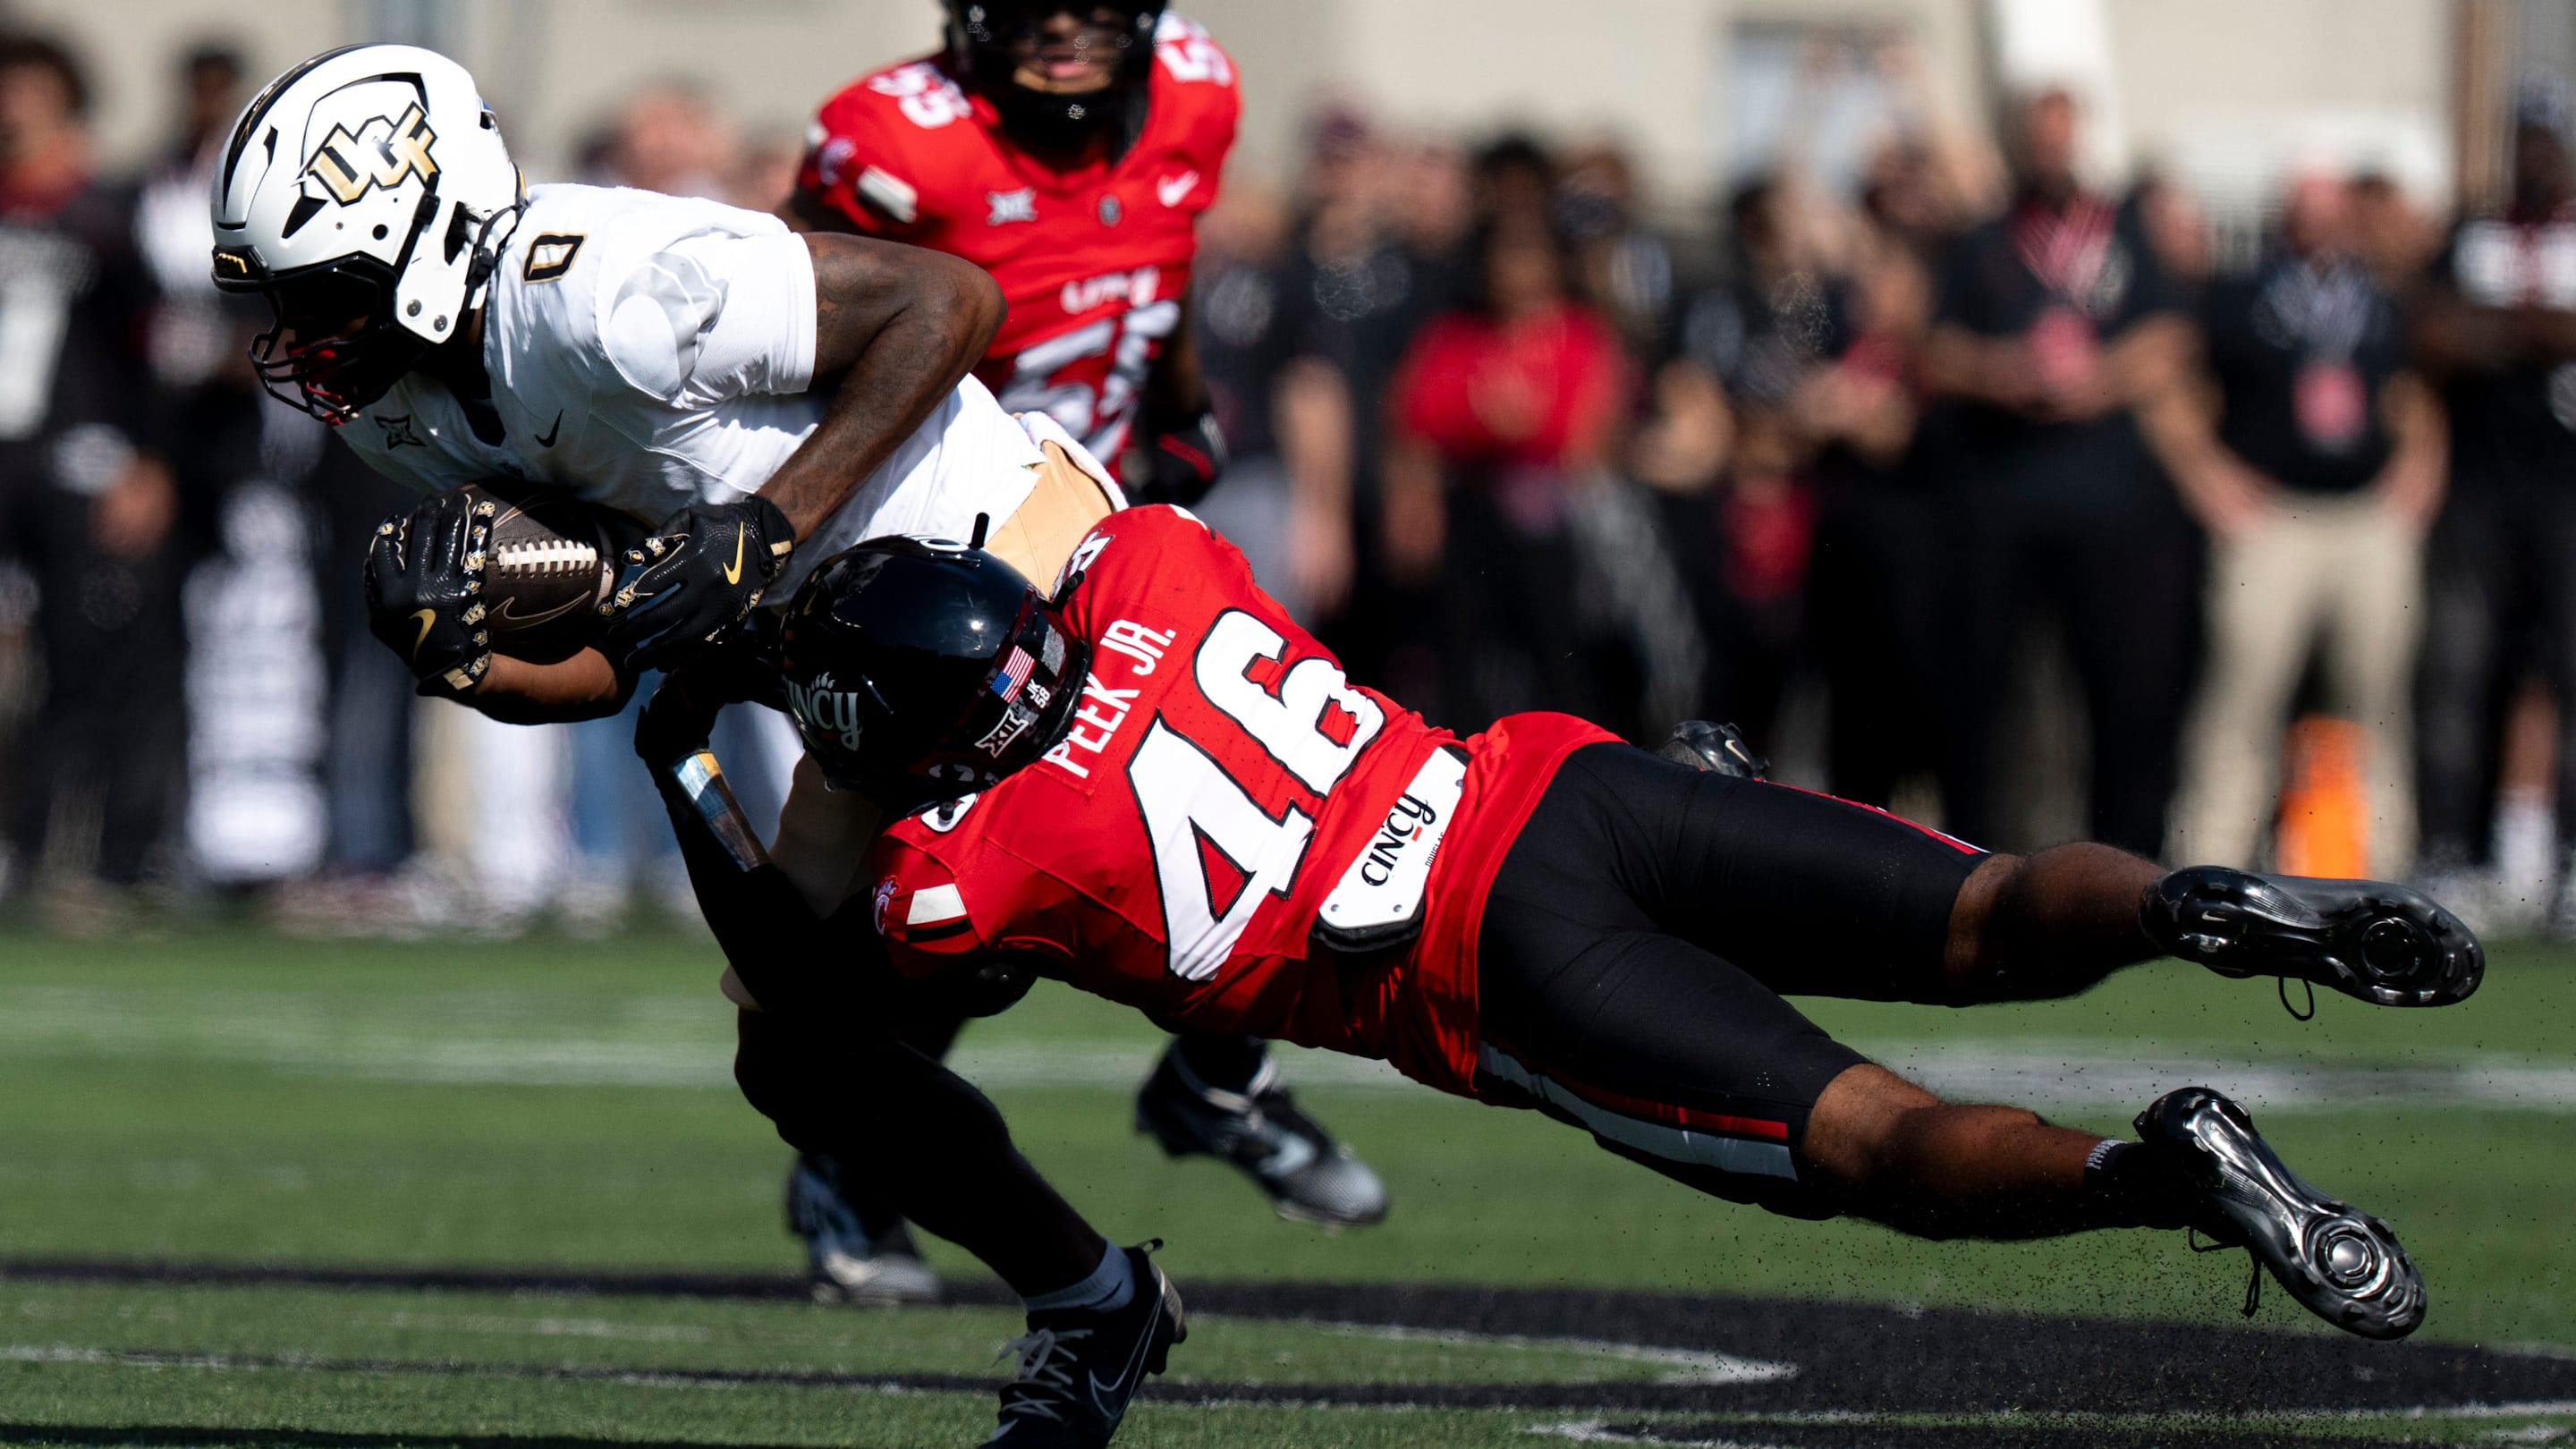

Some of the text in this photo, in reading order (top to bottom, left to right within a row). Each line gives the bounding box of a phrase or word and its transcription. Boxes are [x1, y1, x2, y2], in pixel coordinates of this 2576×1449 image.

[291, 100, 442, 208] UCF
[521, 231, 588, 284] 0
[1027, 678, 1041, 699] JK
[1033, 688, 1051, 709] 58
[1042, 619, 1176, 779] PEEK JR.
[1124, 606, 1388, 982] 46
